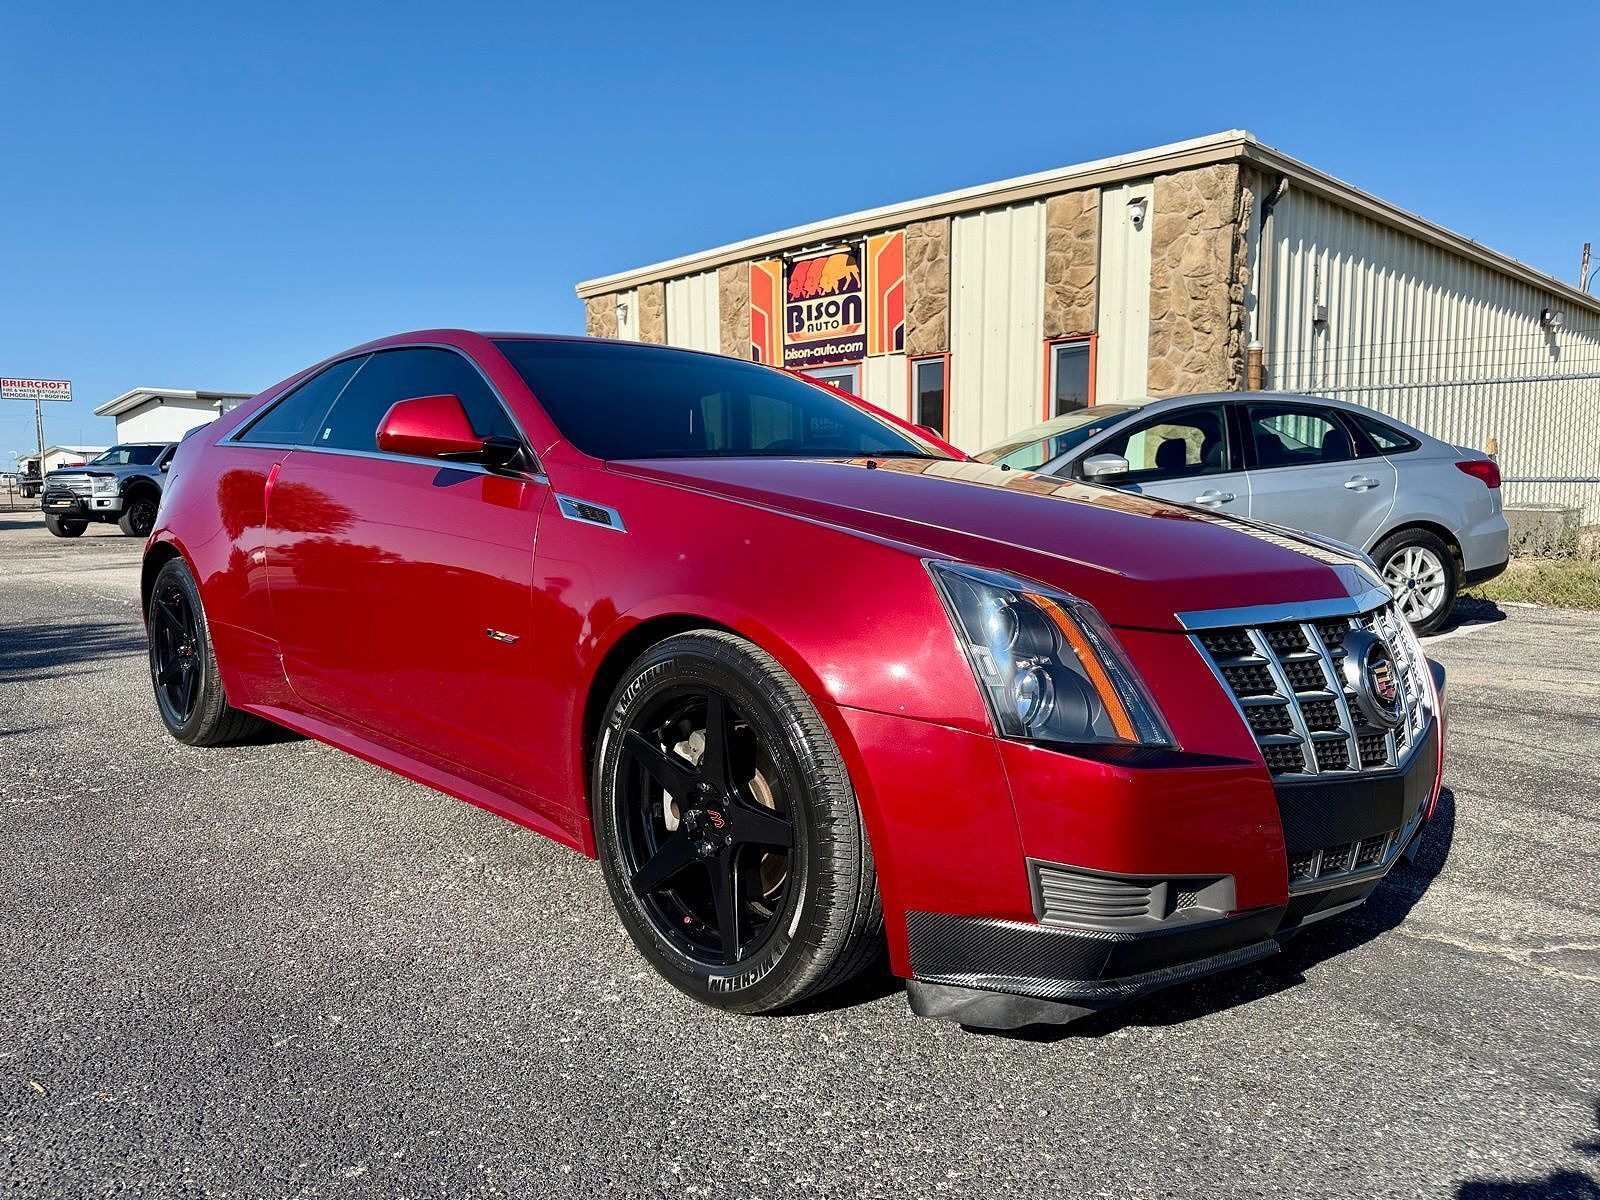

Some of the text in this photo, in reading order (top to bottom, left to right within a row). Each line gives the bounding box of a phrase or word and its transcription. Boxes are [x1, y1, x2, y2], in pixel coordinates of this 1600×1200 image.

[787, 295, 862, 334] BISON
[807, 320, 840, 333] AUTO
[785, 341, 863, 359] bison-auto.com
[2, 379, 69, 389] BRIERCROFT
[708, 955, 777, 993] MICHELIN
